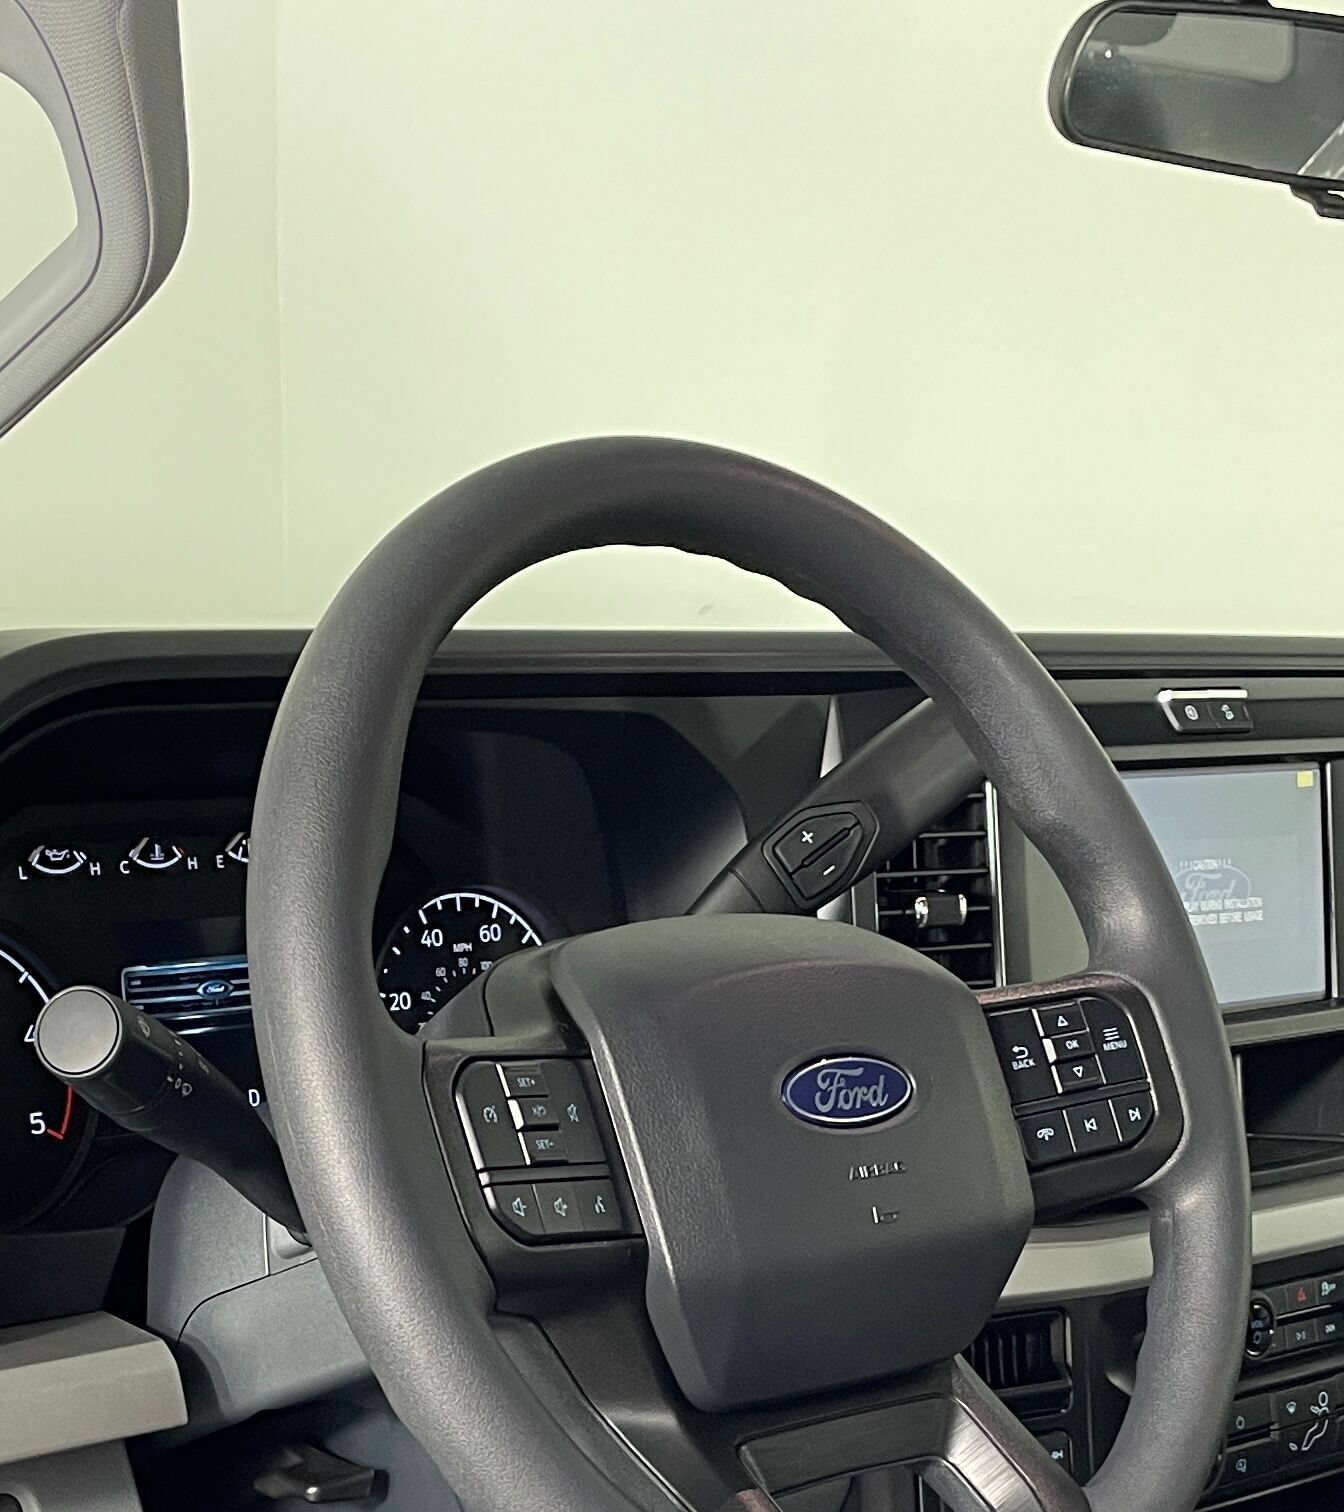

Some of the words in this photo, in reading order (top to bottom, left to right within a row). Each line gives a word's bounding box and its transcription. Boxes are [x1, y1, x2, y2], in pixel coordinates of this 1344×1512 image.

[119, 860, 131, 874] C
[187, 857, 199, 870] H
[216, 855, 225, 869] E
[18, 866, 28, 880] L
[89, 862, 101, 876] H
[420, 928, 444, 947] 40
[479, 923, 502, 943] 60
[452, 942, 473, 953] MPH
[389, 991, 412, 1011] 20
[1065, 1039, 1080, 1050] OK
[1102, 1040, 1128, 1051] MENU
[1011, 1058, 1036, 1071] BACK
[814, 1067, 889, 1113] Ford
[29, 1111, 46, 1135] 5
